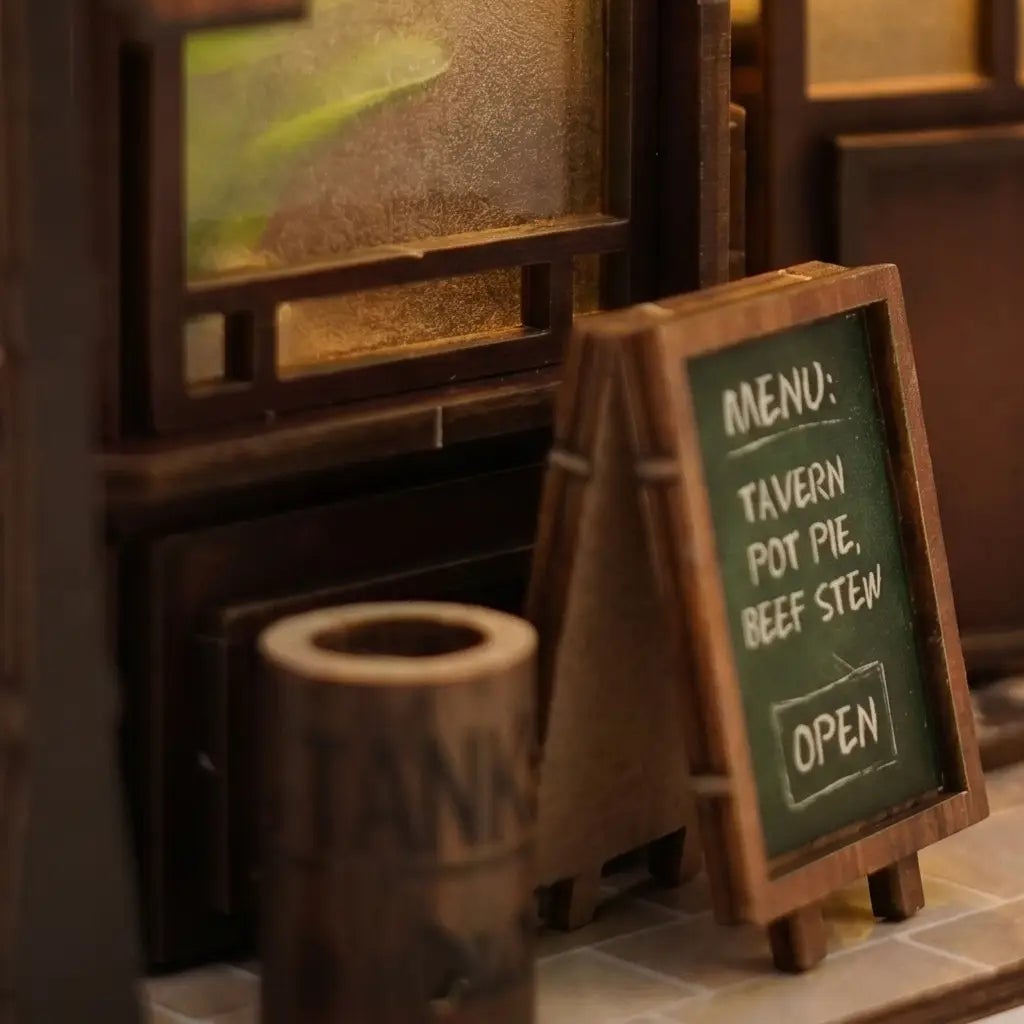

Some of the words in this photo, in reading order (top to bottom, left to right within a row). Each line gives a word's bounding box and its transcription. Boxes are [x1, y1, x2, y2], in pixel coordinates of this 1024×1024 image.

[722, 361, 837, 437] MENU:
[736, 455, 845, 523] TAVERN
[747, 530, 800, 587] POT
[809, 514, 861, 564] PIE,
[741, 590, 805, 650] BEEF
[814, 563, 881, 622] STEW
[793, 696, 878, 775] OPEN
